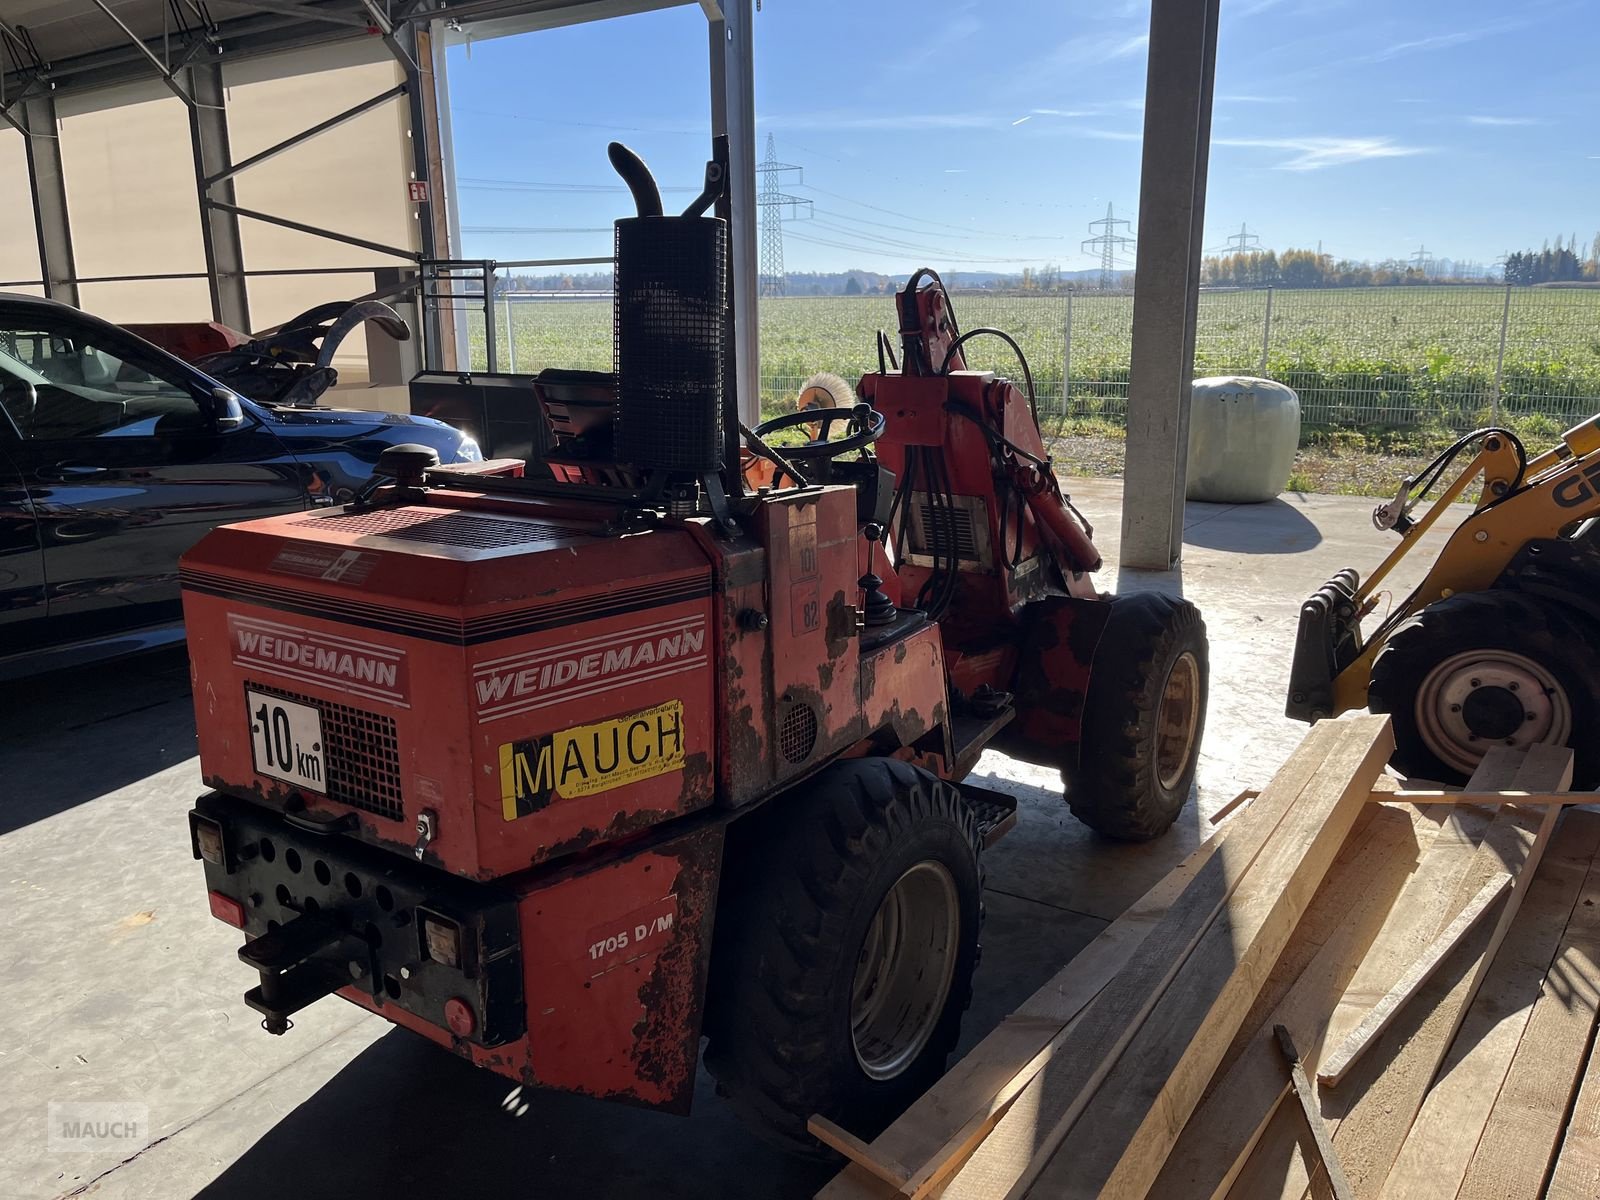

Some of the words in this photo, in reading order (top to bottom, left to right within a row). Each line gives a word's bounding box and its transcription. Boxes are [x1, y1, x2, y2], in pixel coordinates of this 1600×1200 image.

[237, 630, 397, 688] WEIDEMANN
[475, 628, 705, 705] WEIDEMANN
[256, 703, 293, 773] 10
[296, 744, 321, 782] km
[515, 711, 682, 799] MAUCH
[589, 932, 629, 960] 1705
[635, 913, 673, 942] D/M
